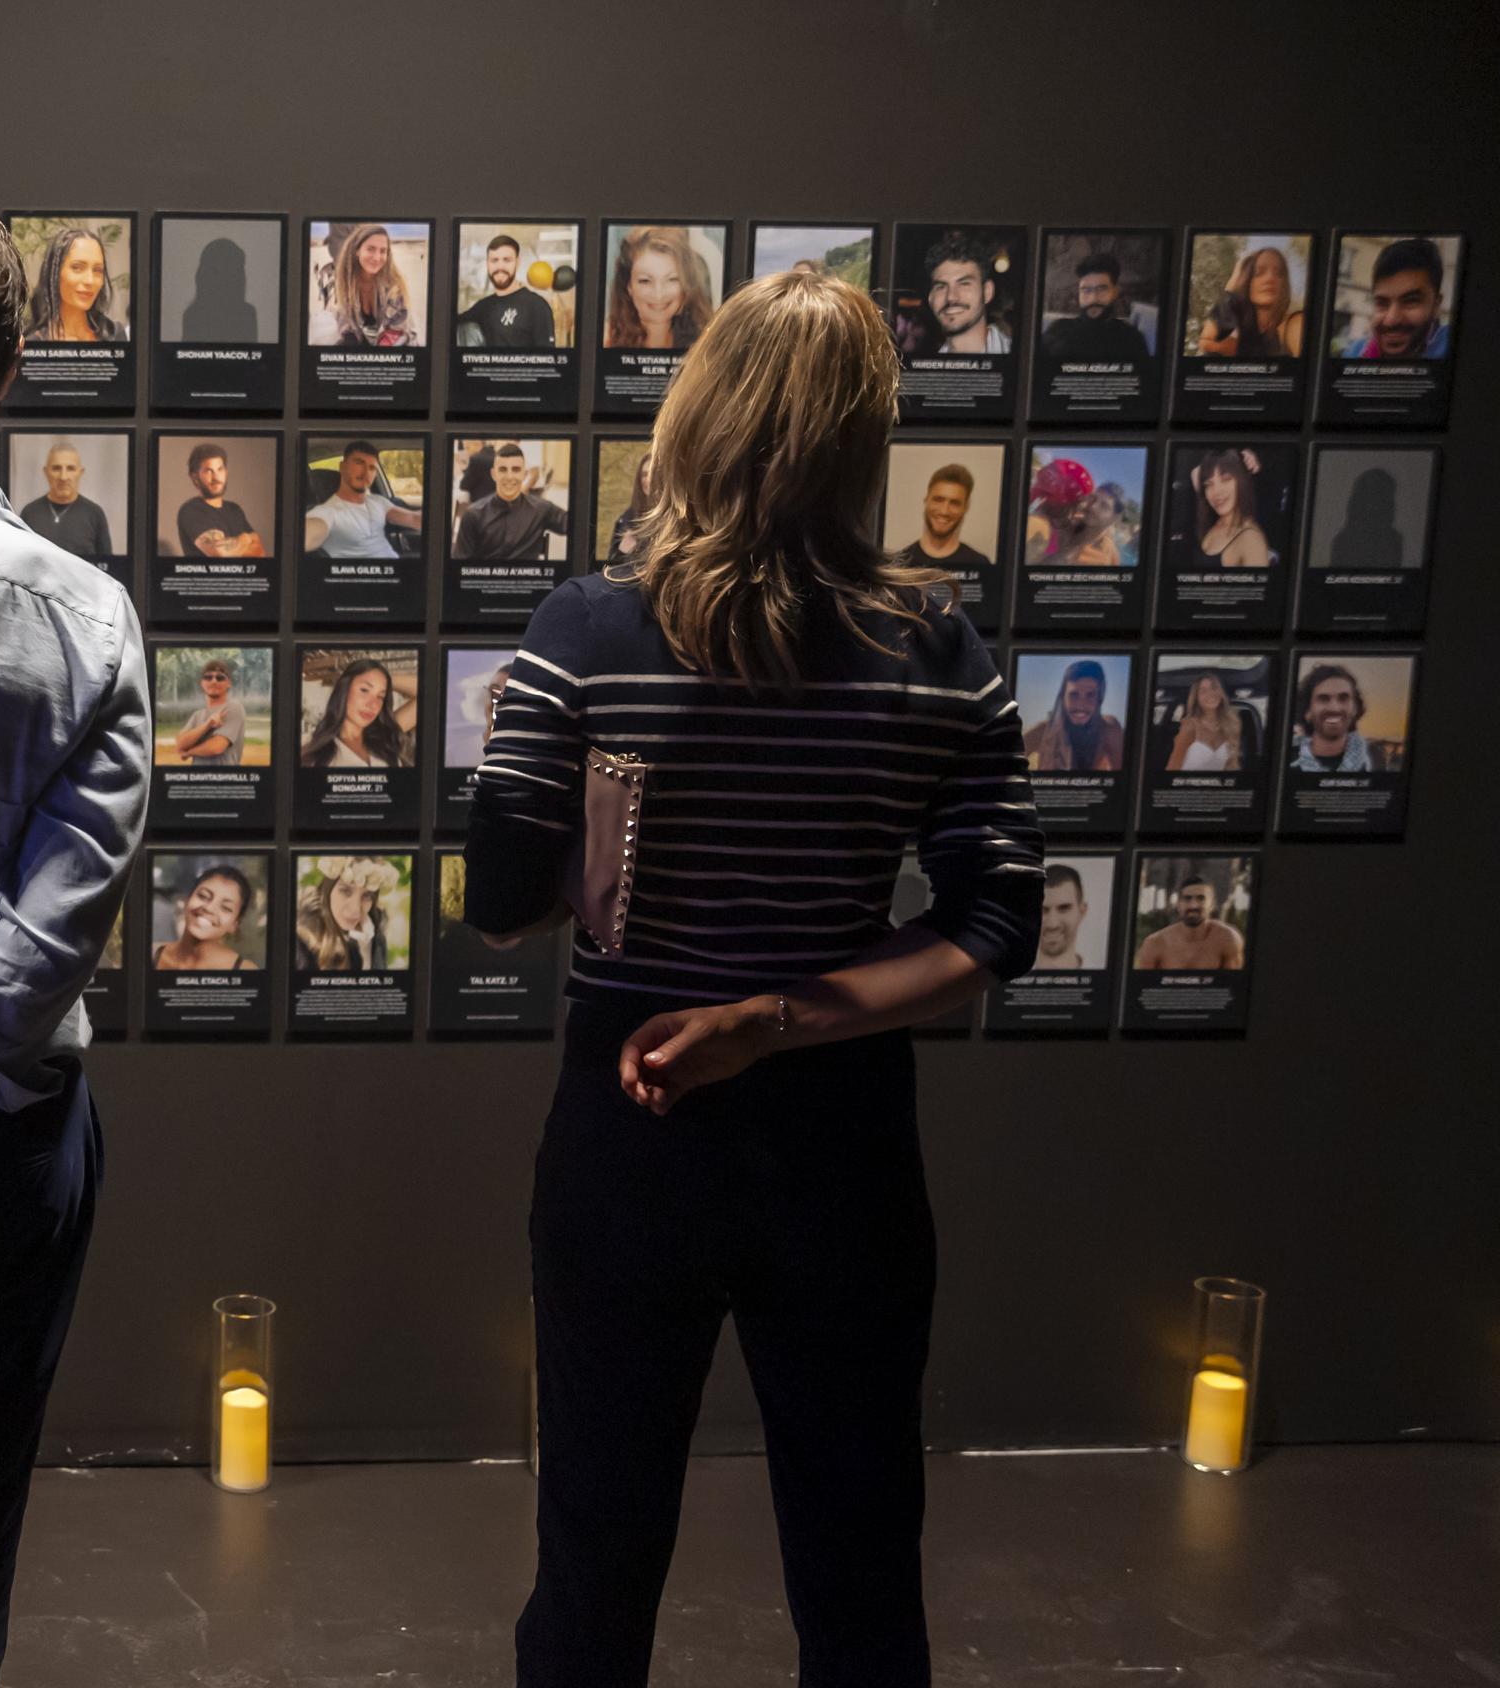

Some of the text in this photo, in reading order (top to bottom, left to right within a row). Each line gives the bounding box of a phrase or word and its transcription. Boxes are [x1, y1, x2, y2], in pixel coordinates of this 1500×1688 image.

[20, 349, 47, 358] HIRAN
[48, 349, 78, 358] SABINA
[176, 351, 262, 360] SHOHAM YAACOV, 29
[320, 353, 344, 363] SIVAN
[405, 353, 414, 363] 21
[462, 354, 490, 364] STIVEN
[556, 354, 568, 364] 25
[621, 355, 636, 365] TAL
[637, 355, 671, 365] TATIANA
[175, 564, 208, 574] SHOVAL
[246, 564, 257, 574] 27
[330, 565, 356, 575] SLAVA
[461, 567, 491, 577] SUHAIB
[491, 567, 509, 577] ABU
[164, 773, 189, 782] SHON
[249, 773, 260, 782] 26
[327, 774, 388, 783] SOFIYA MORIEL
[374, 784, 383, 793] 21
[176, 976, 199, 986] SIGAL
[310, 977, 330, 986] STAV
[330, 977, 357, 986] KORAL
[470, 976, 484, 985] TAL
